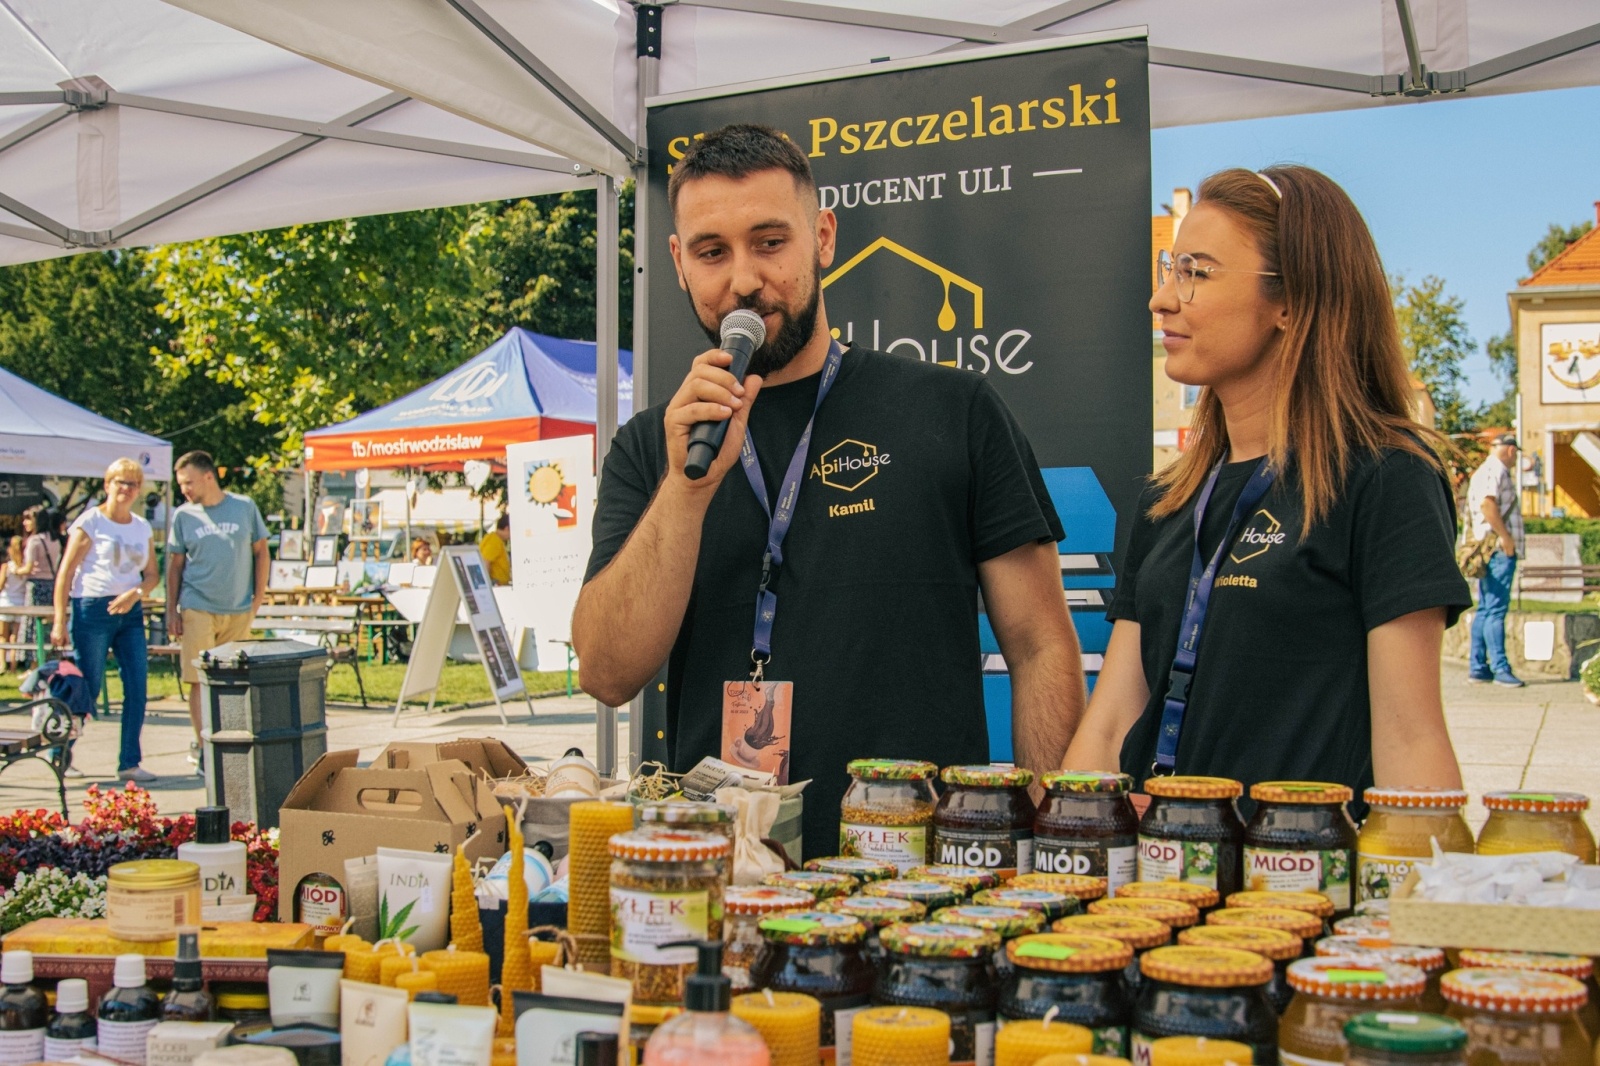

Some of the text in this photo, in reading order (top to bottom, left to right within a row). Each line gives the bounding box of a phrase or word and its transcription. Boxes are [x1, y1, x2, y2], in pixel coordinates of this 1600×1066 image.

[807, 78, 1121, 158] Pszczelarski
[818, 165, 1012, 211] DUCENT ULI
[809, 452, 891, 480] ApiHouse
[828, 498, 876, 518] Kamil
[1240, 527, 1286, 545] House
[846, 828, 909, 844] PYŁEK
[941, 841, 1002, 867] MIÓD
[1035, 848, 1091, 875] MIÓD
[1254, 852, 1315, 872] MIÓD
[205, 872, 235, 891] DIA
[390, 872, 430, 889] INDIA
